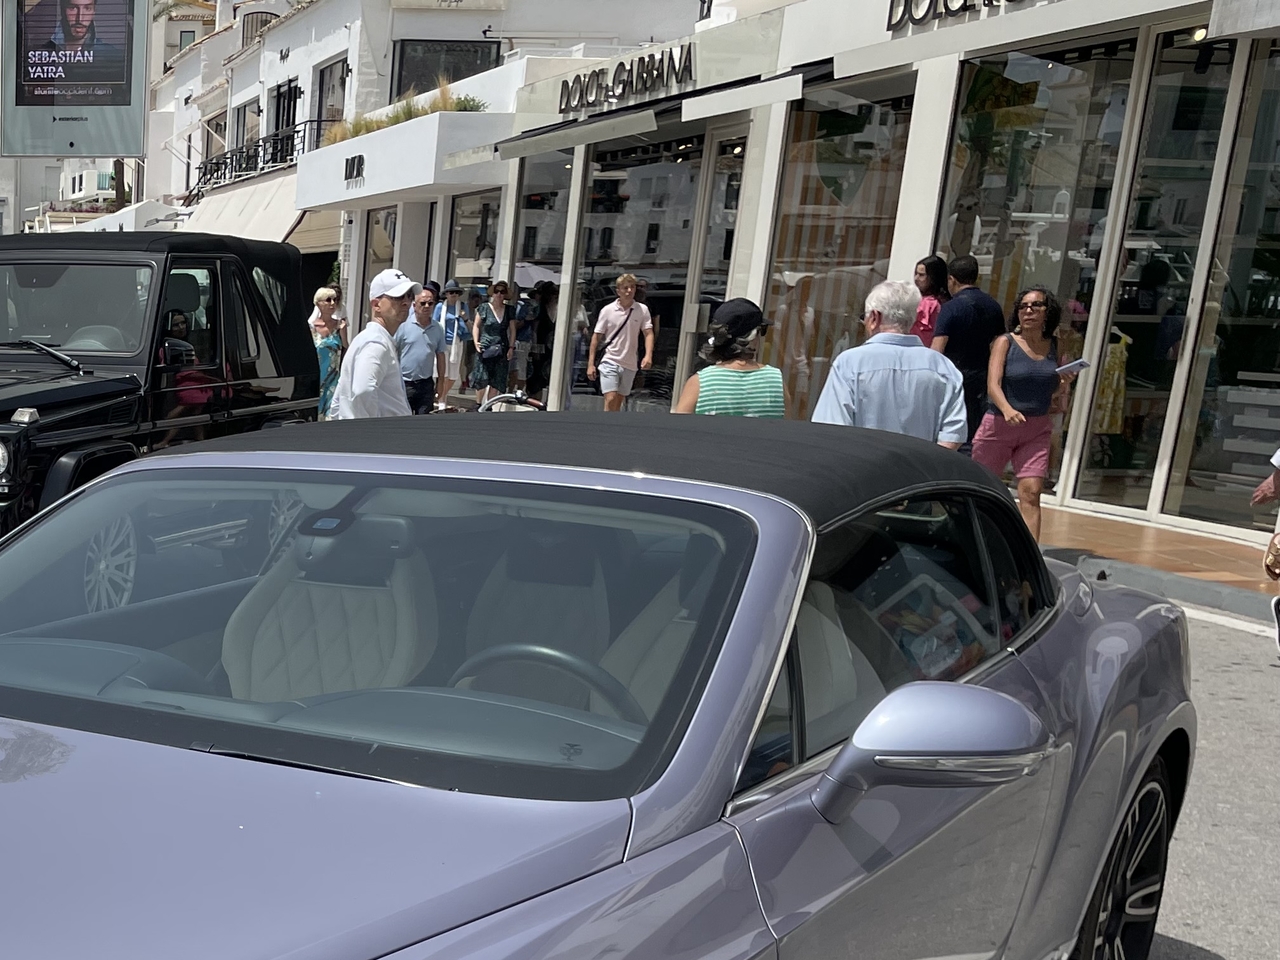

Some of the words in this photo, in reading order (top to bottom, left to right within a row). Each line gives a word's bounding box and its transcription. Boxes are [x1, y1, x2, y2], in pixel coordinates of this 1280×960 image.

[28, 46, 93, 63] SEBASTIÁN
[28, 66, 65, 78] YATRA
[613, 42, 697, 98] GABBANA
